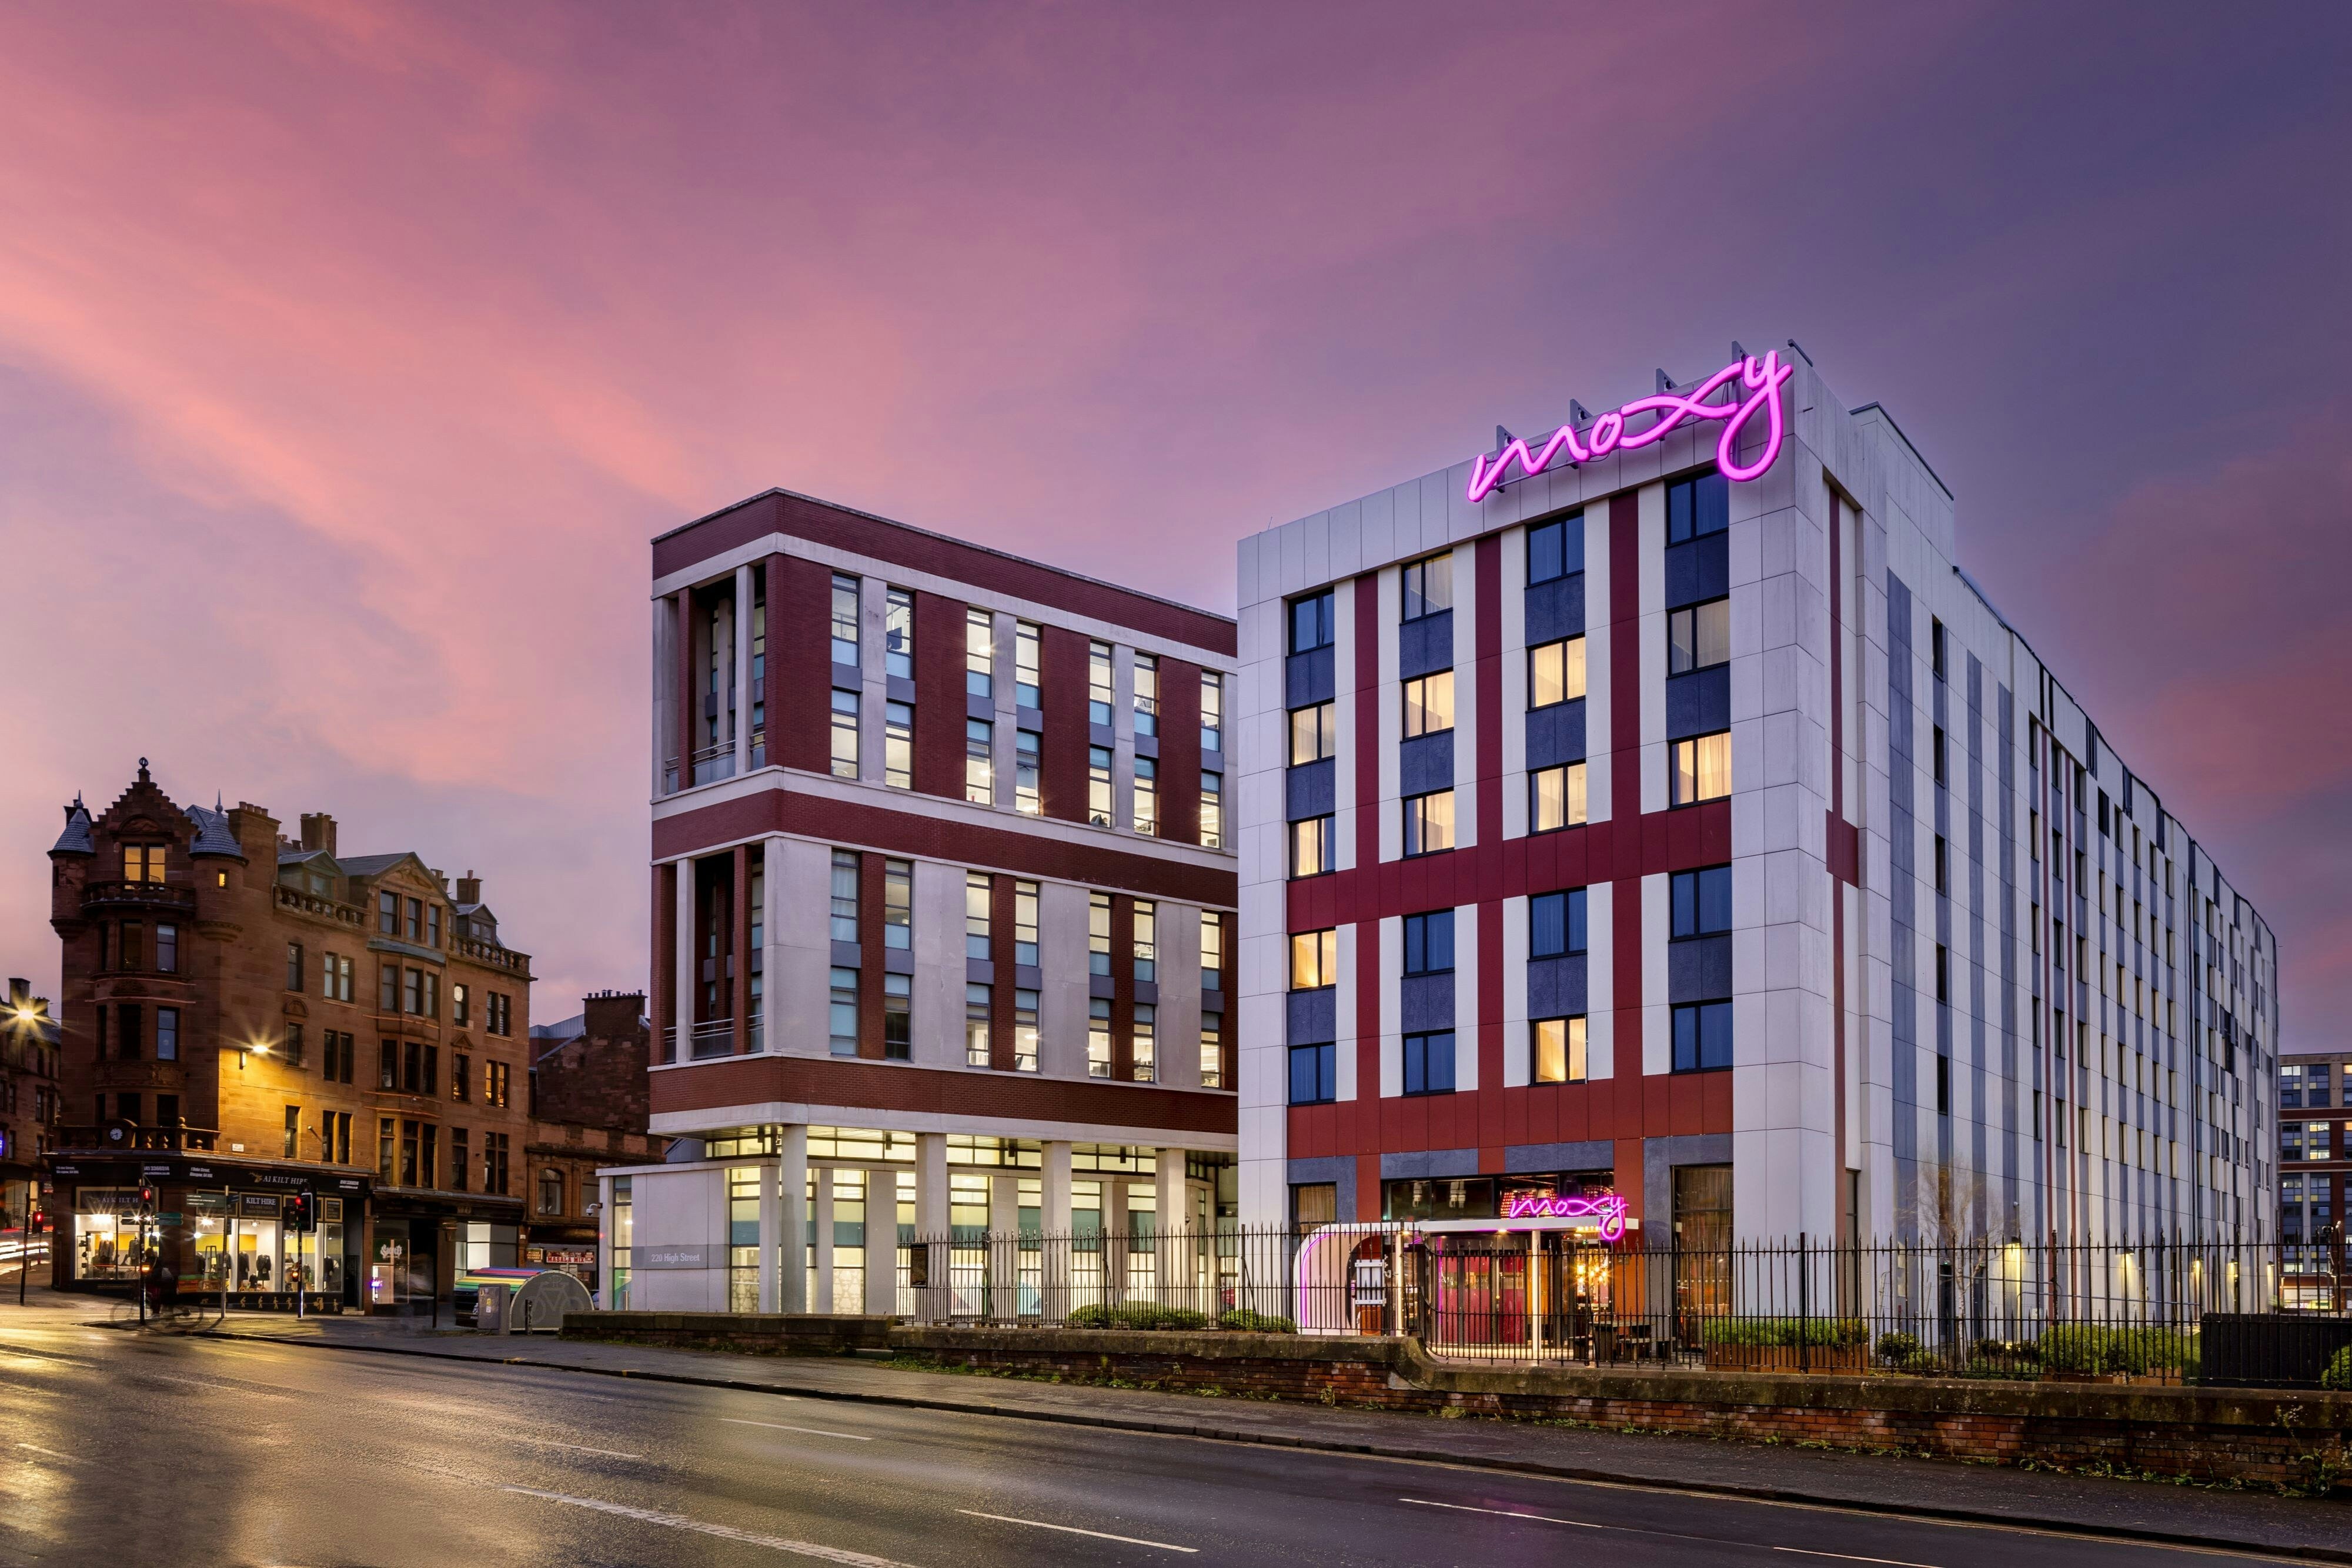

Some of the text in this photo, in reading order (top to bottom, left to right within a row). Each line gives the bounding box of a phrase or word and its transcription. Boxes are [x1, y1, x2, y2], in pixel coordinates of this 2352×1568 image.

[1467, 350, 1793, 503] moxy
[1509, 1196, 1629, 1241] moxy
[651, 1252, 700, 1263] 220 High Street
